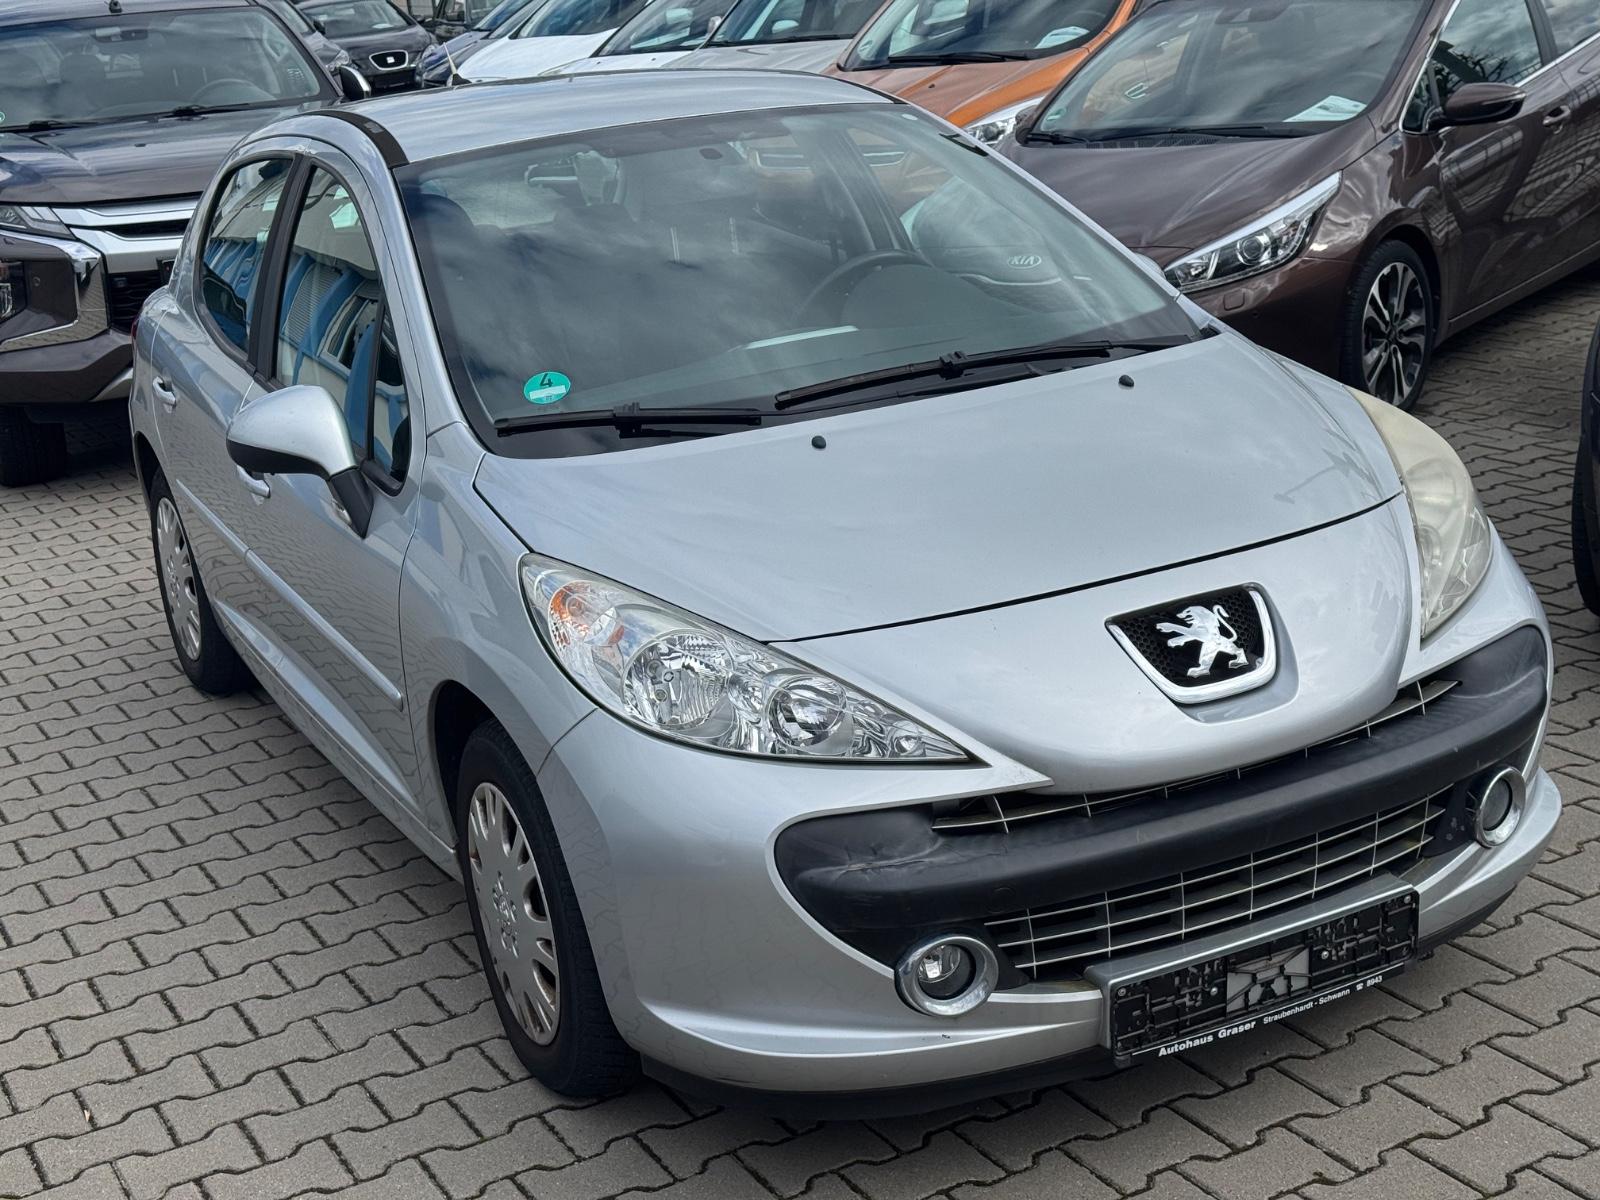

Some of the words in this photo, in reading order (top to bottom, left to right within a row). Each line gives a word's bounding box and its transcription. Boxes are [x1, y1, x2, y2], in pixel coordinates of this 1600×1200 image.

[540, 373, 553, 387] 4
[1158, 1034, 1214, 1057] Autohaus
[1218, 1021, 1256, 1038] Graser
[1263, 1002, 1314, 1024] Straubenhardt
[1318, 989, 1351, 1006] Schwann
